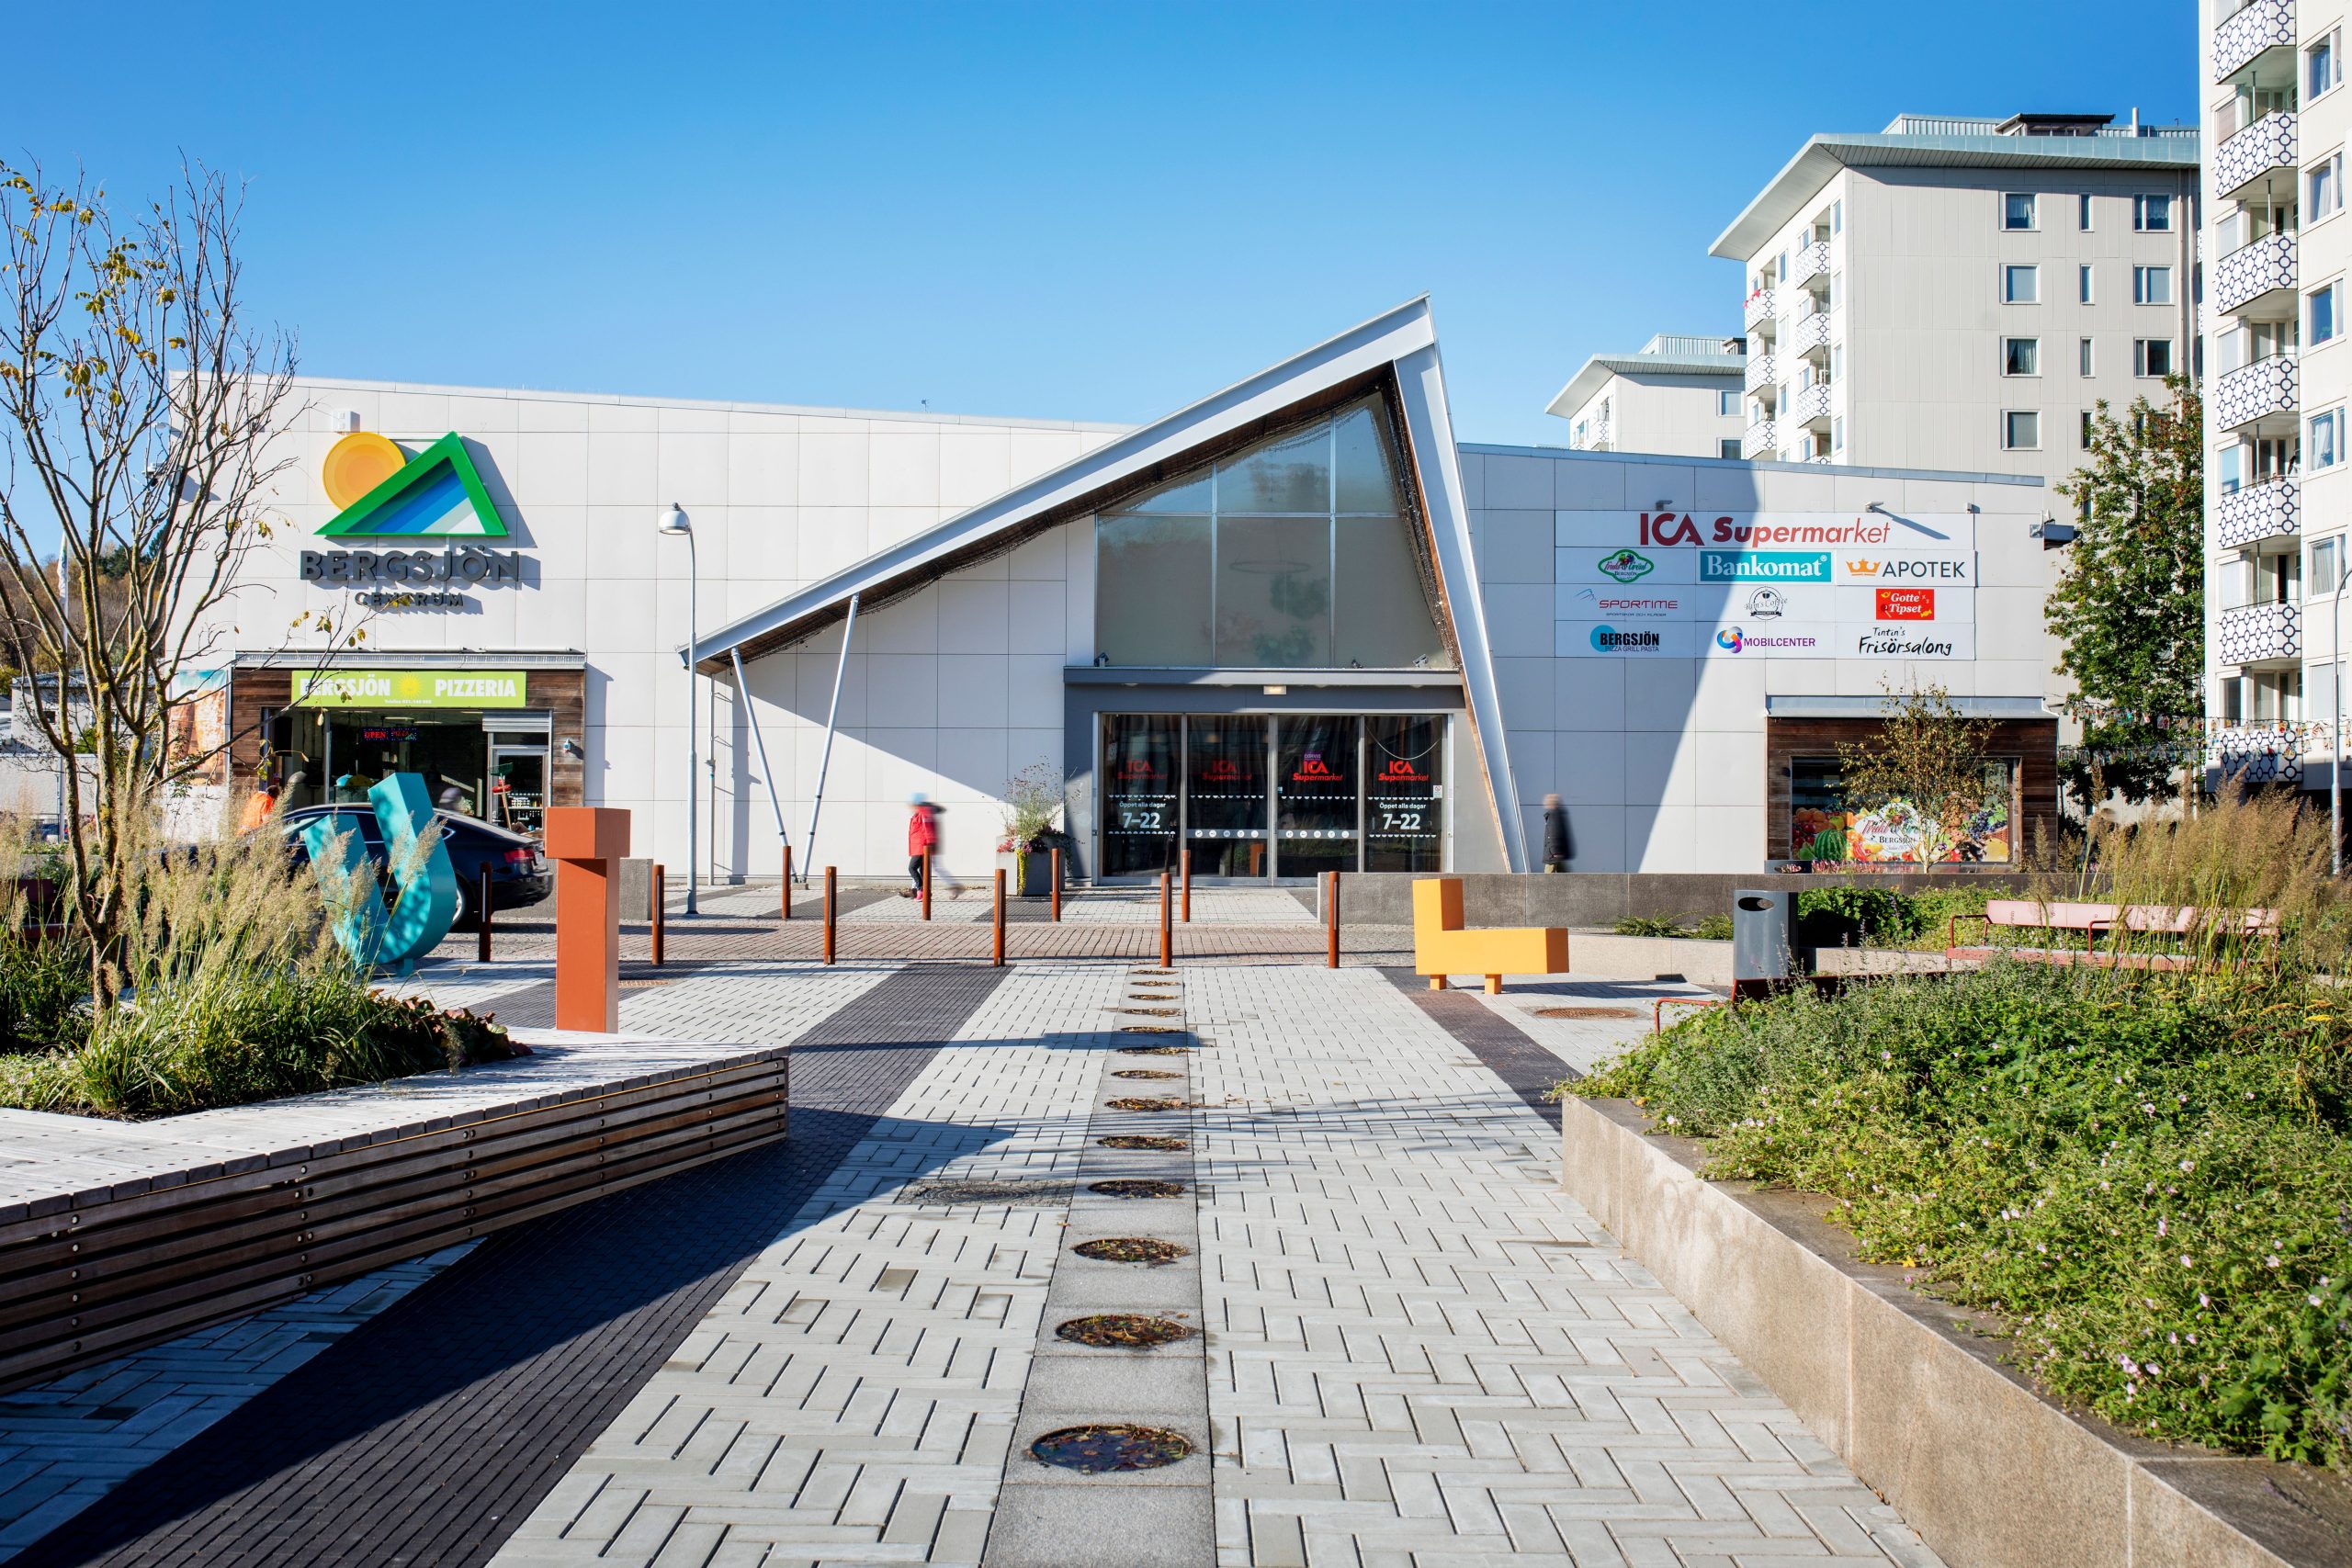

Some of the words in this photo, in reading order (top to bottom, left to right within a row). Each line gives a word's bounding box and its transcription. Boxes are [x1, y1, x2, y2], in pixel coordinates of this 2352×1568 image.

[1640, 513, 1705, 546] ICA
[1713, 516, 1891, 547] Supermarket
[300, 544, 519, 581] BERGSJÖN
[1882, 561, 1965, 578] APOTEK
[1891, 592, 1919, 603] Gotte
[1600, 600, 1678, 609] SPORTIME
[1889, 604, 1922, 615] Tipset
[1872, 626, 1905, 636] Tintin's
[1600, 631, 1659, 646] BERGSJÖN
[1744, 637, 1815, 647] MOBILCENTER
[1859, 636, 1952, 656] Frisörsalong
[300, 674, 390, 696] BERGSJÖN
[435, 679, 516, 697] PIZZERIA
[364, 730, 386, 739] OPEN
[1126, 760, 1152, 773] ICA
[1212, 760, 1237, 773] ICA
[1303, 761, 1329, 773] ICA
[1388, 761, 1414, 773] ICA
[1293, 773, 1343, 782] Supermarket
[1378, 773, 1430, 782] Supermarket
[1119, 800, 1137, 808] Öppet
